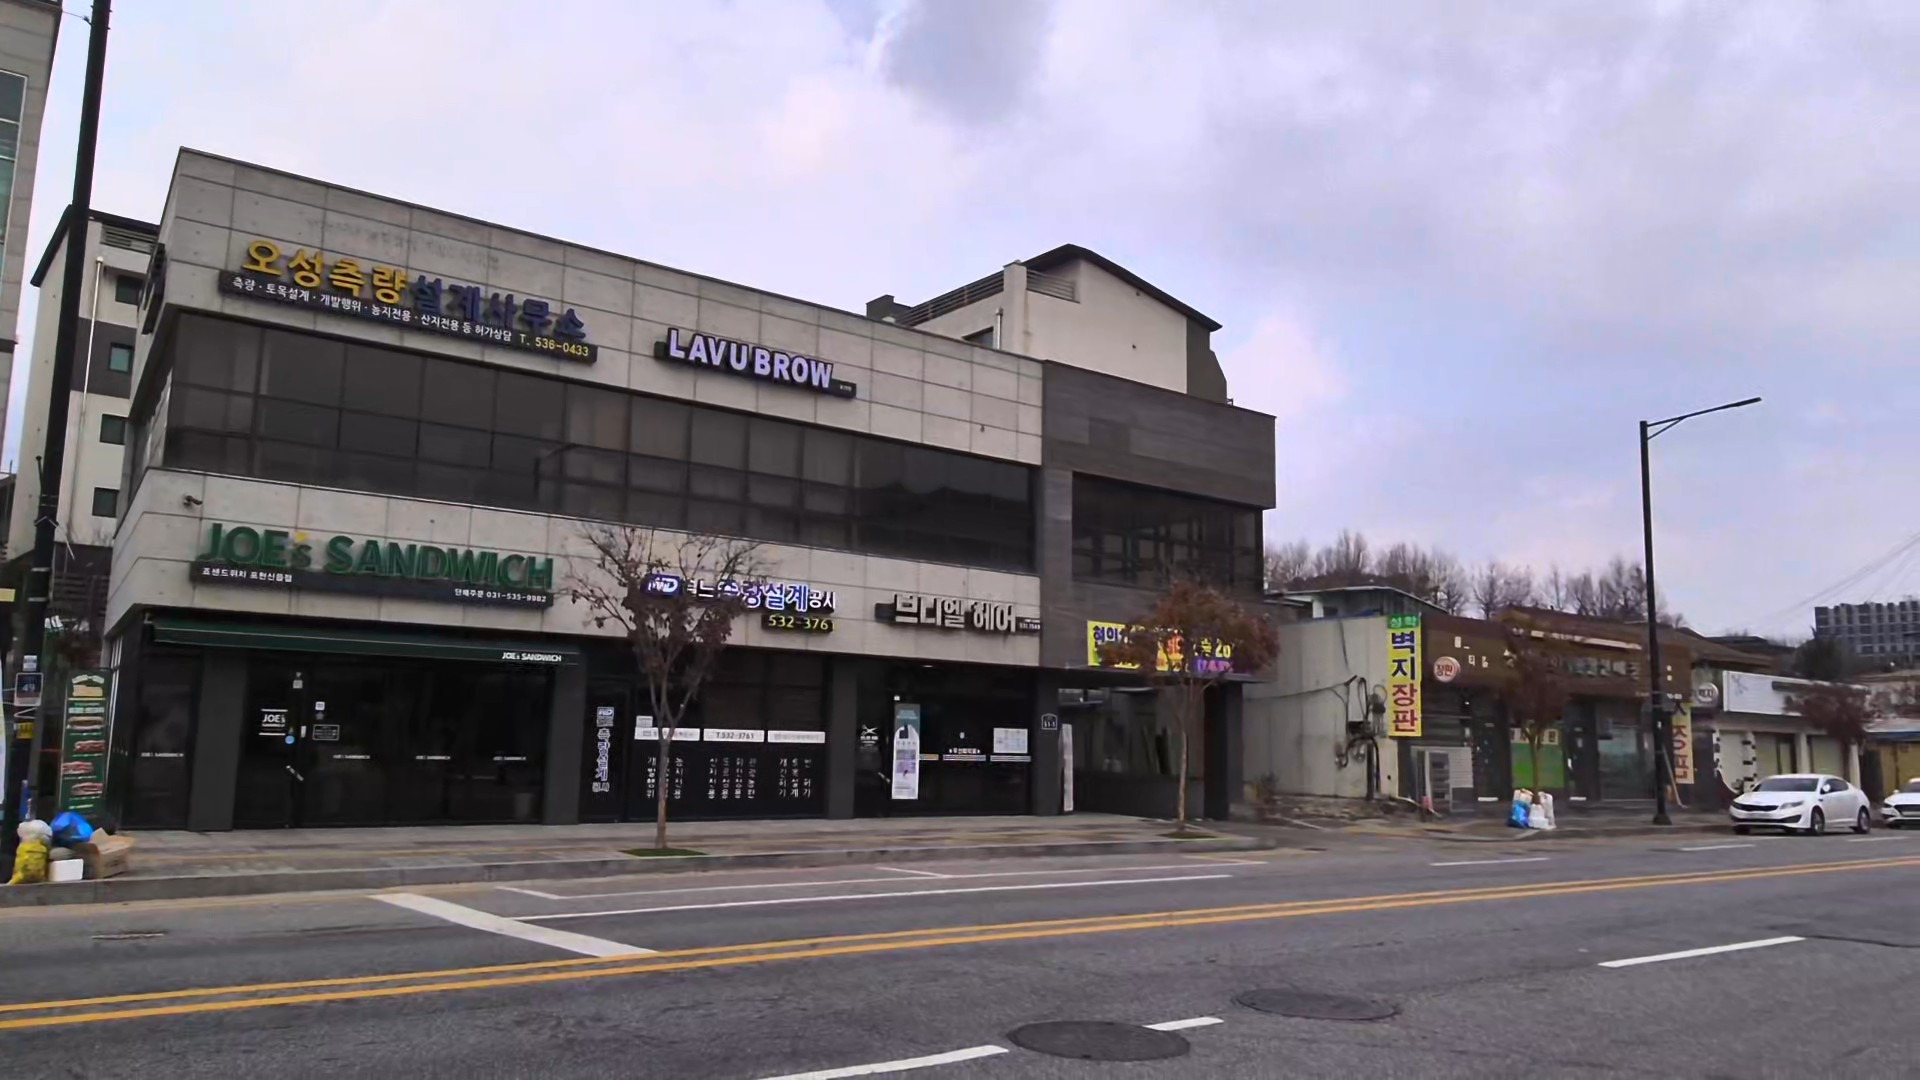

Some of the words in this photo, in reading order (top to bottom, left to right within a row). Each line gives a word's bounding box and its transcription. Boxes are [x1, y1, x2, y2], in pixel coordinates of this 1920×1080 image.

[240, 239, 408, 304] 오성측량
[233, 276, 256, 292] 측량
[265, 283, 310, 304] 토목설계
[320, 293, 362, 314] 개발행위
[371, 303, 412, 324] 농지전용
[420, 313, 459, 331] 산지전용
[462, 322, 471, 335] 등
[475, 324, 512, 342] 허가상담
[535, 336, 589, 357] 536-0433
[324, 535, 554, 589] SANDWICH
[971, 600, 1016, 632] 헤어
[1391, 630, 1418, 733] 벽지장판
